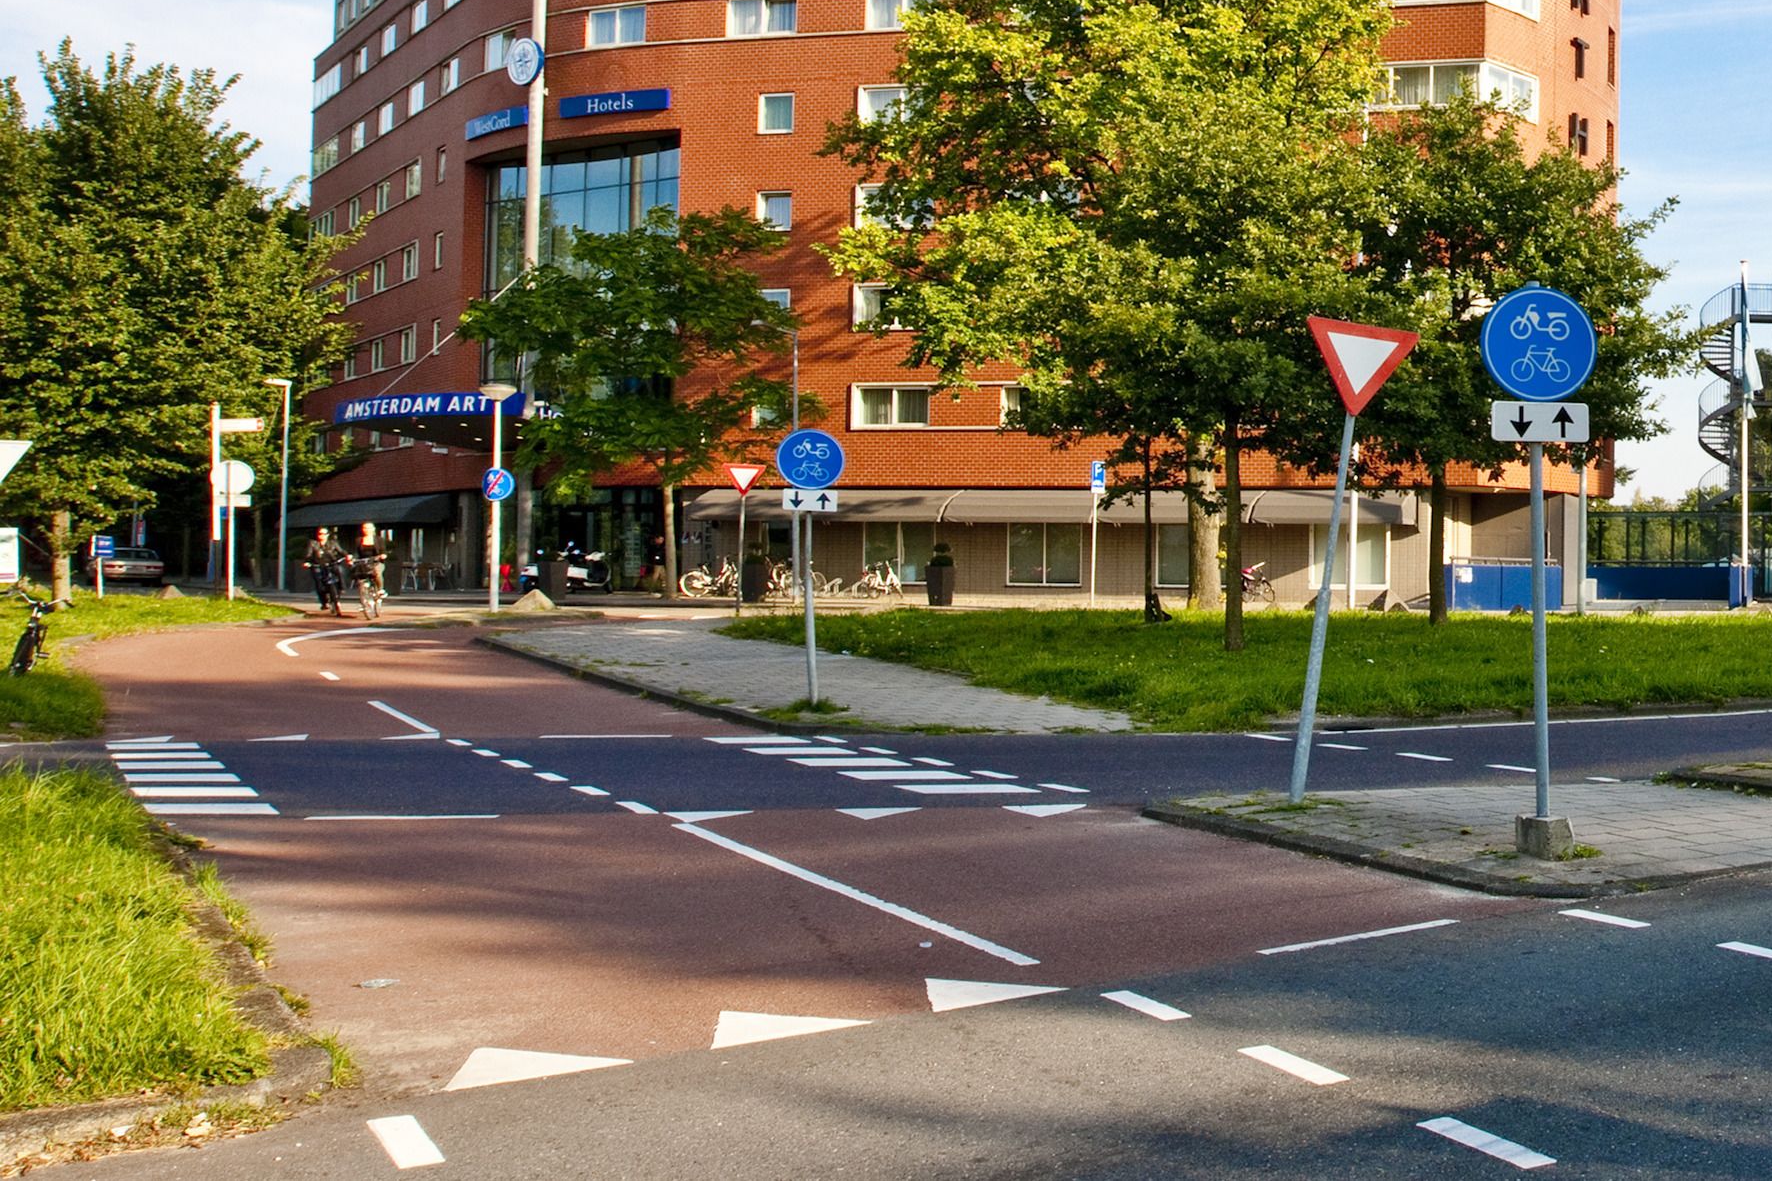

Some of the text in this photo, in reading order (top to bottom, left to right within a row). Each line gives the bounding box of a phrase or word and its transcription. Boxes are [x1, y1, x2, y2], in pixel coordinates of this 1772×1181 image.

[587, 93, 633, 113] Hotels
[344, 394, 489, 419] AMSTERDAM ART
